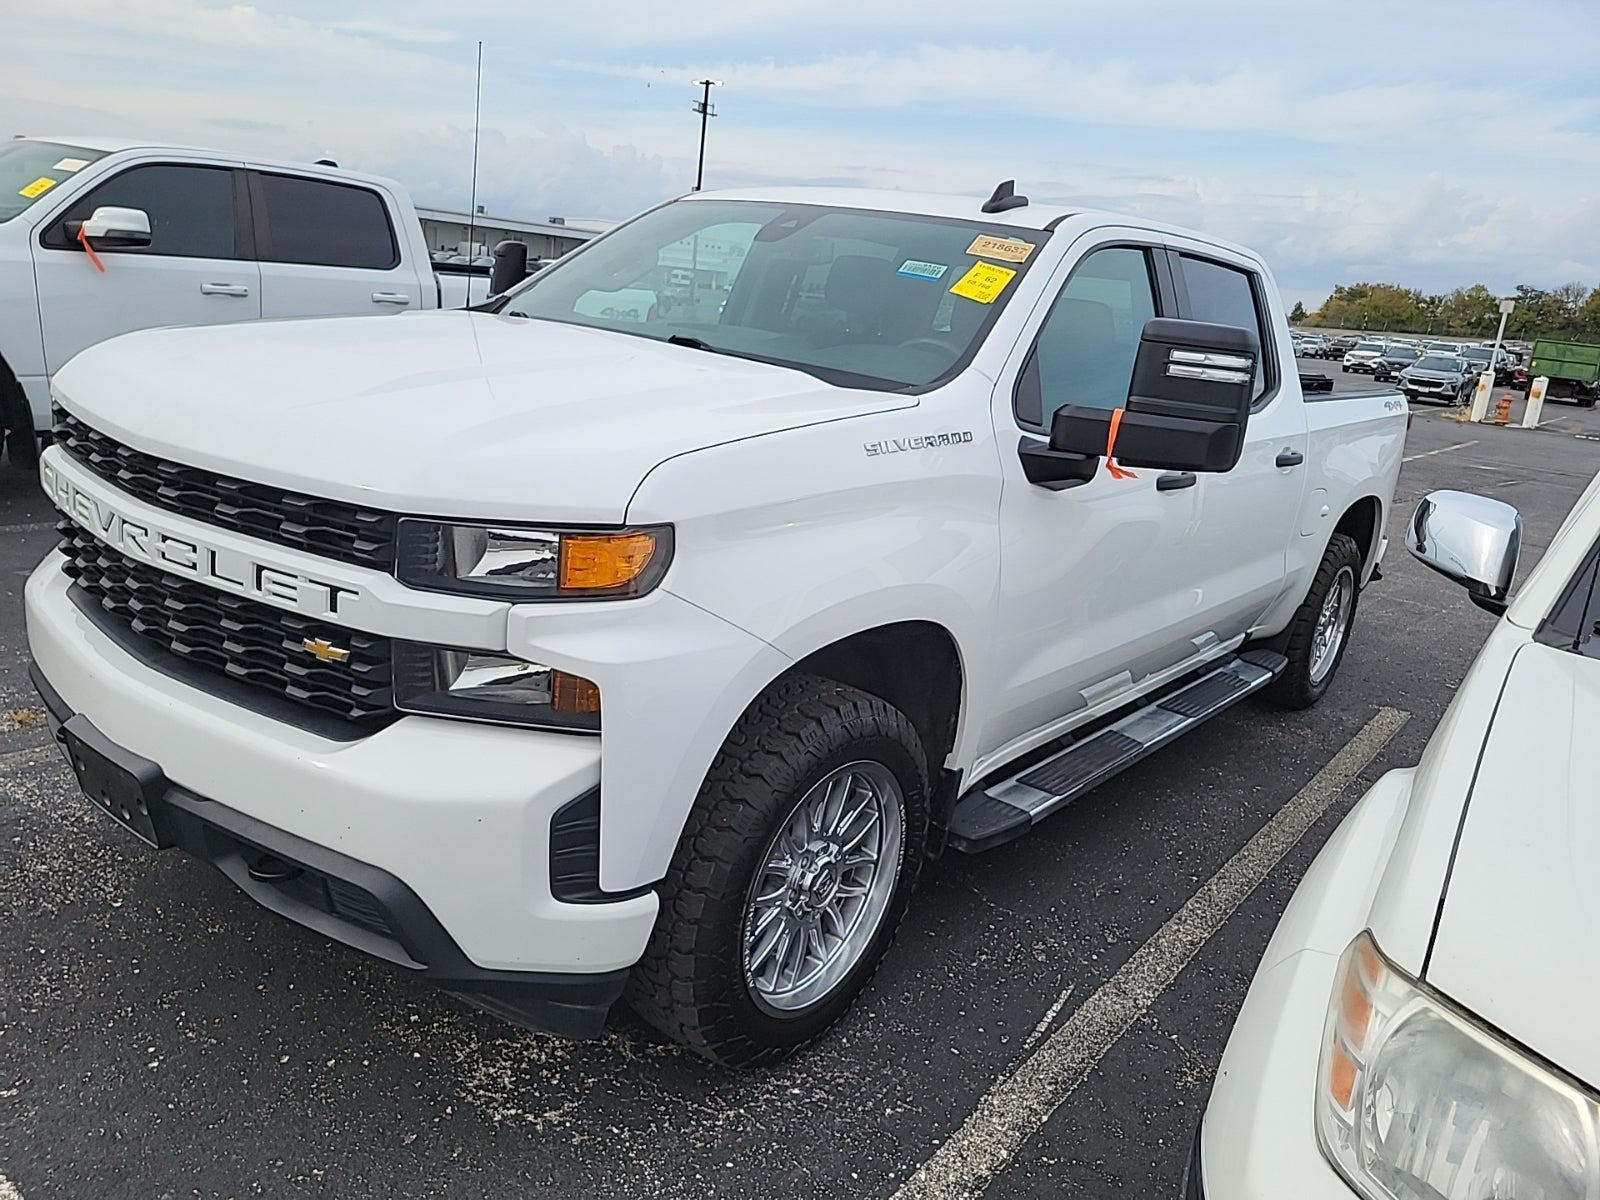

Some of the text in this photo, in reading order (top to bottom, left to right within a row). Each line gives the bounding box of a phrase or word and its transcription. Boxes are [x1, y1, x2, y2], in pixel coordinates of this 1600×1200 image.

[981, 240, 1029, 255] 218637
[863, 431, 974, 457] SILVERADO
[43, 463, 361, 618] CHEVROLET
